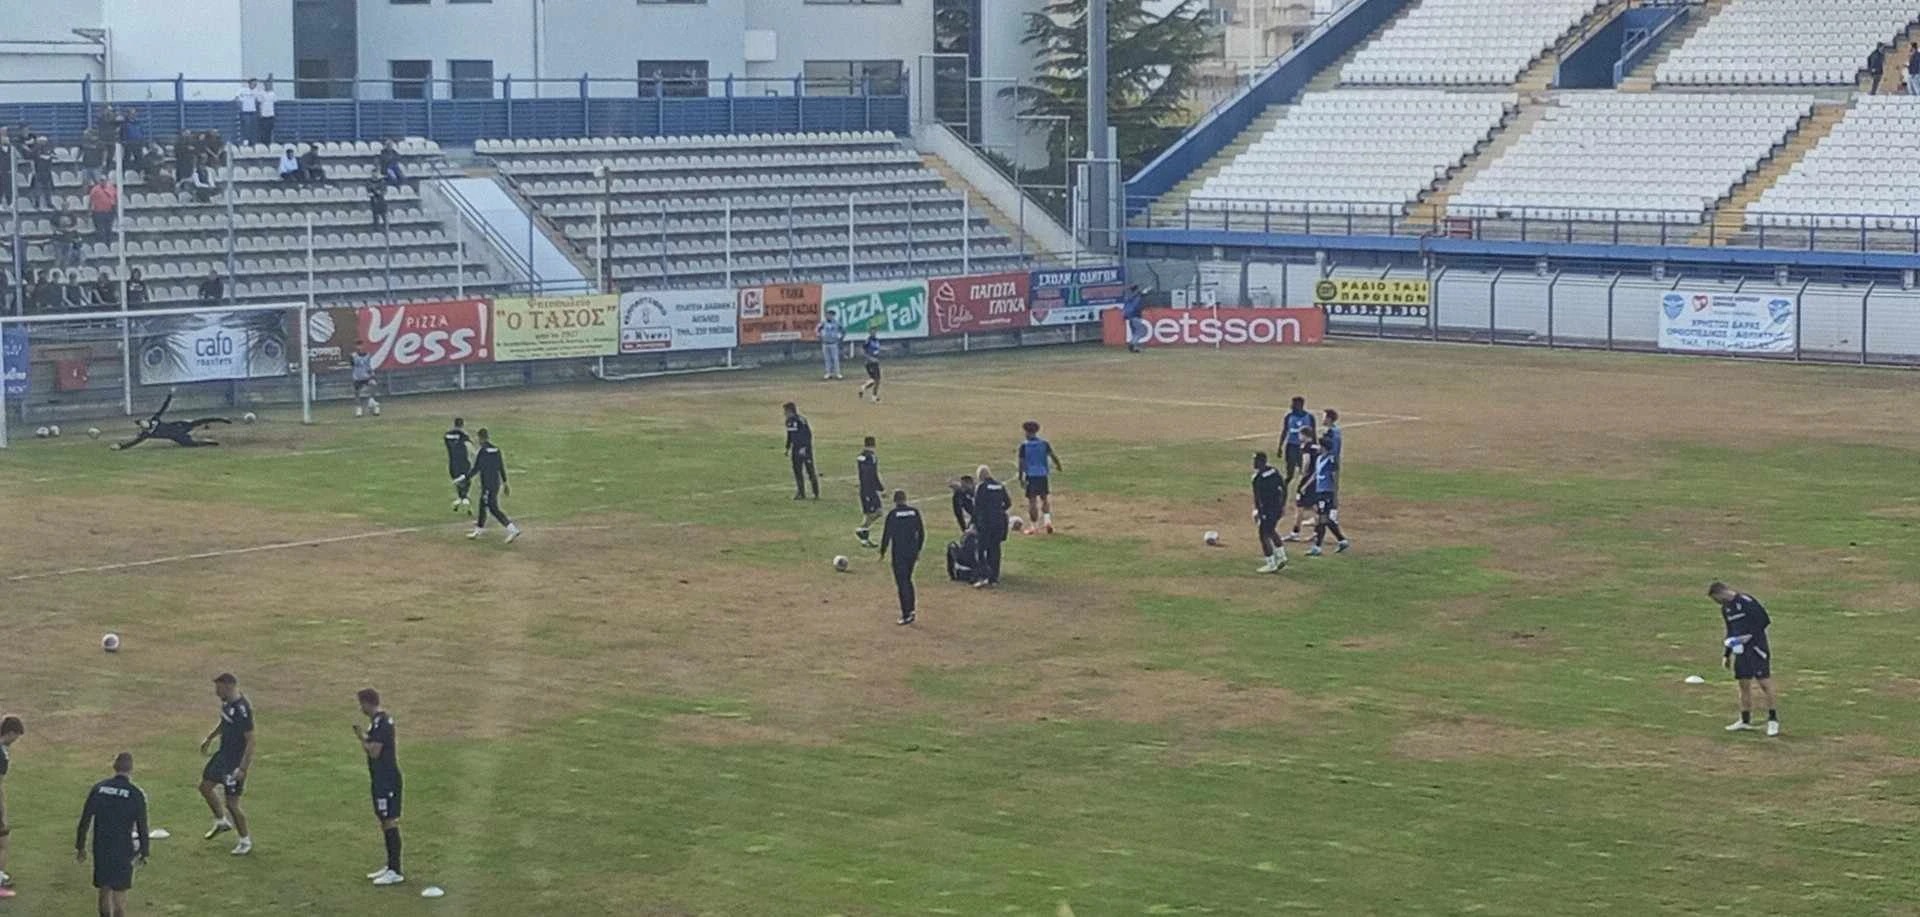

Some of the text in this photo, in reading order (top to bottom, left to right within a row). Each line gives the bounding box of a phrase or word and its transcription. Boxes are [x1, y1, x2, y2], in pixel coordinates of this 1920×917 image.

[970, 281, 1017, 300] ΠΑΓΩΤΑ
[989, 297, 1026, 315] ΓΛΥΚΑ
[406, 315, 449, 329] PIZZA
[1125, 312, 1301, 344] betsson
[367, 302, 488, 370] Yess!
